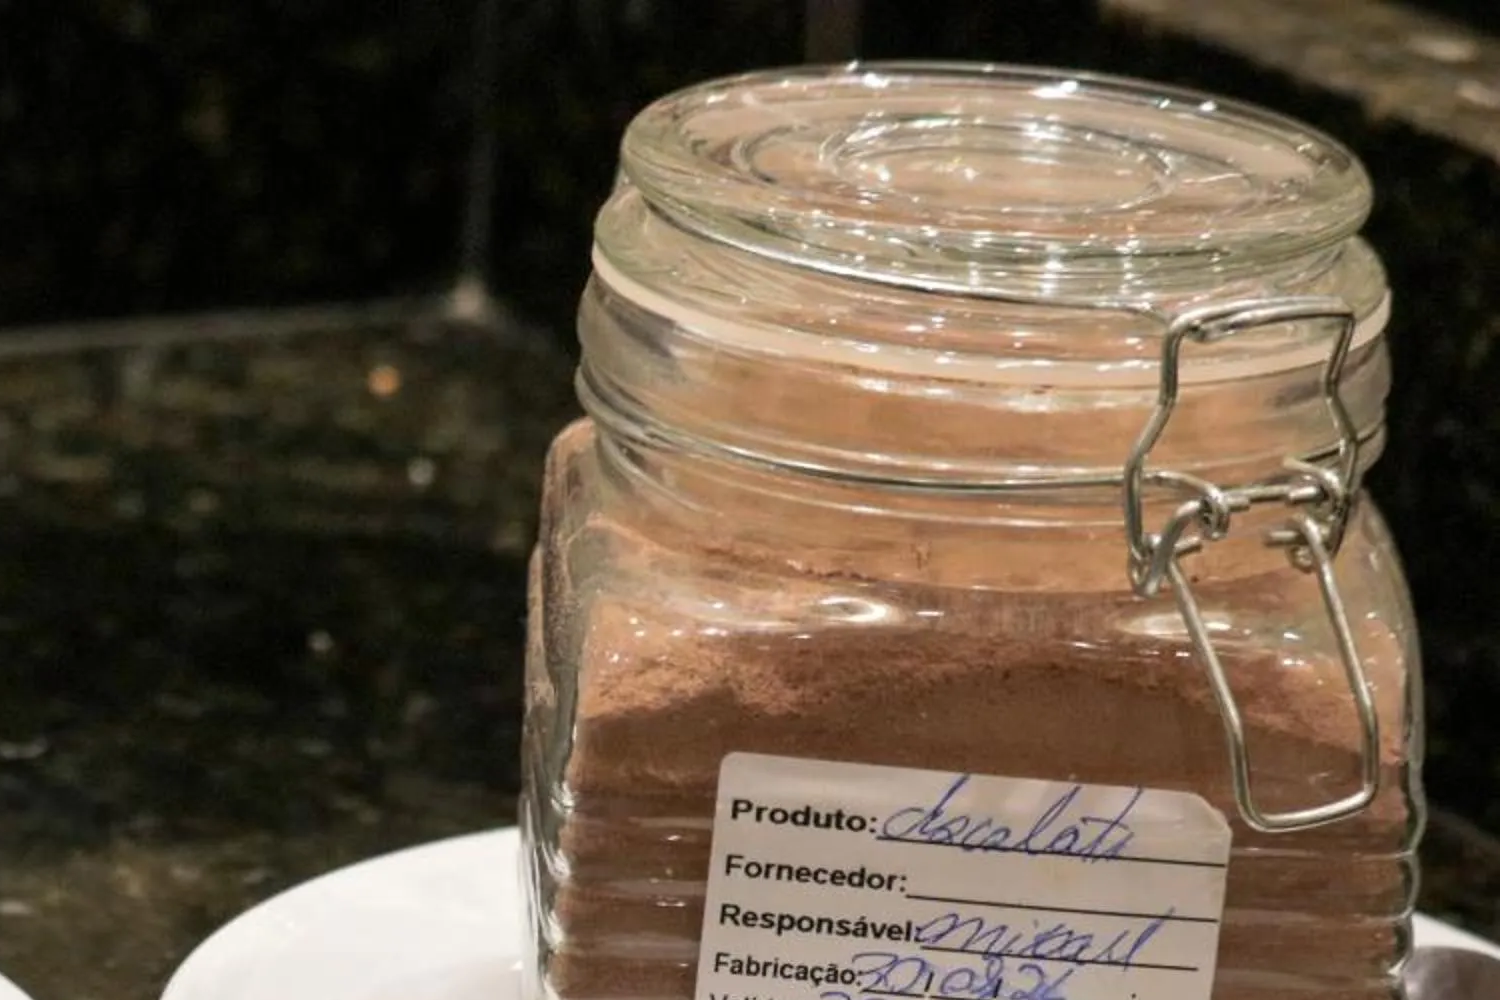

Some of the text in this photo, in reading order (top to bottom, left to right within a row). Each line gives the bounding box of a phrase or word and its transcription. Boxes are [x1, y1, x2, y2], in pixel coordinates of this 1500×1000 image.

[730, 798, 878, 834] Produto:
[723, 853, 907, 893] Fornecedor:
[718, 903, 922, 945] Responsável:
[713, 952, 864, 988] Fabricação:
